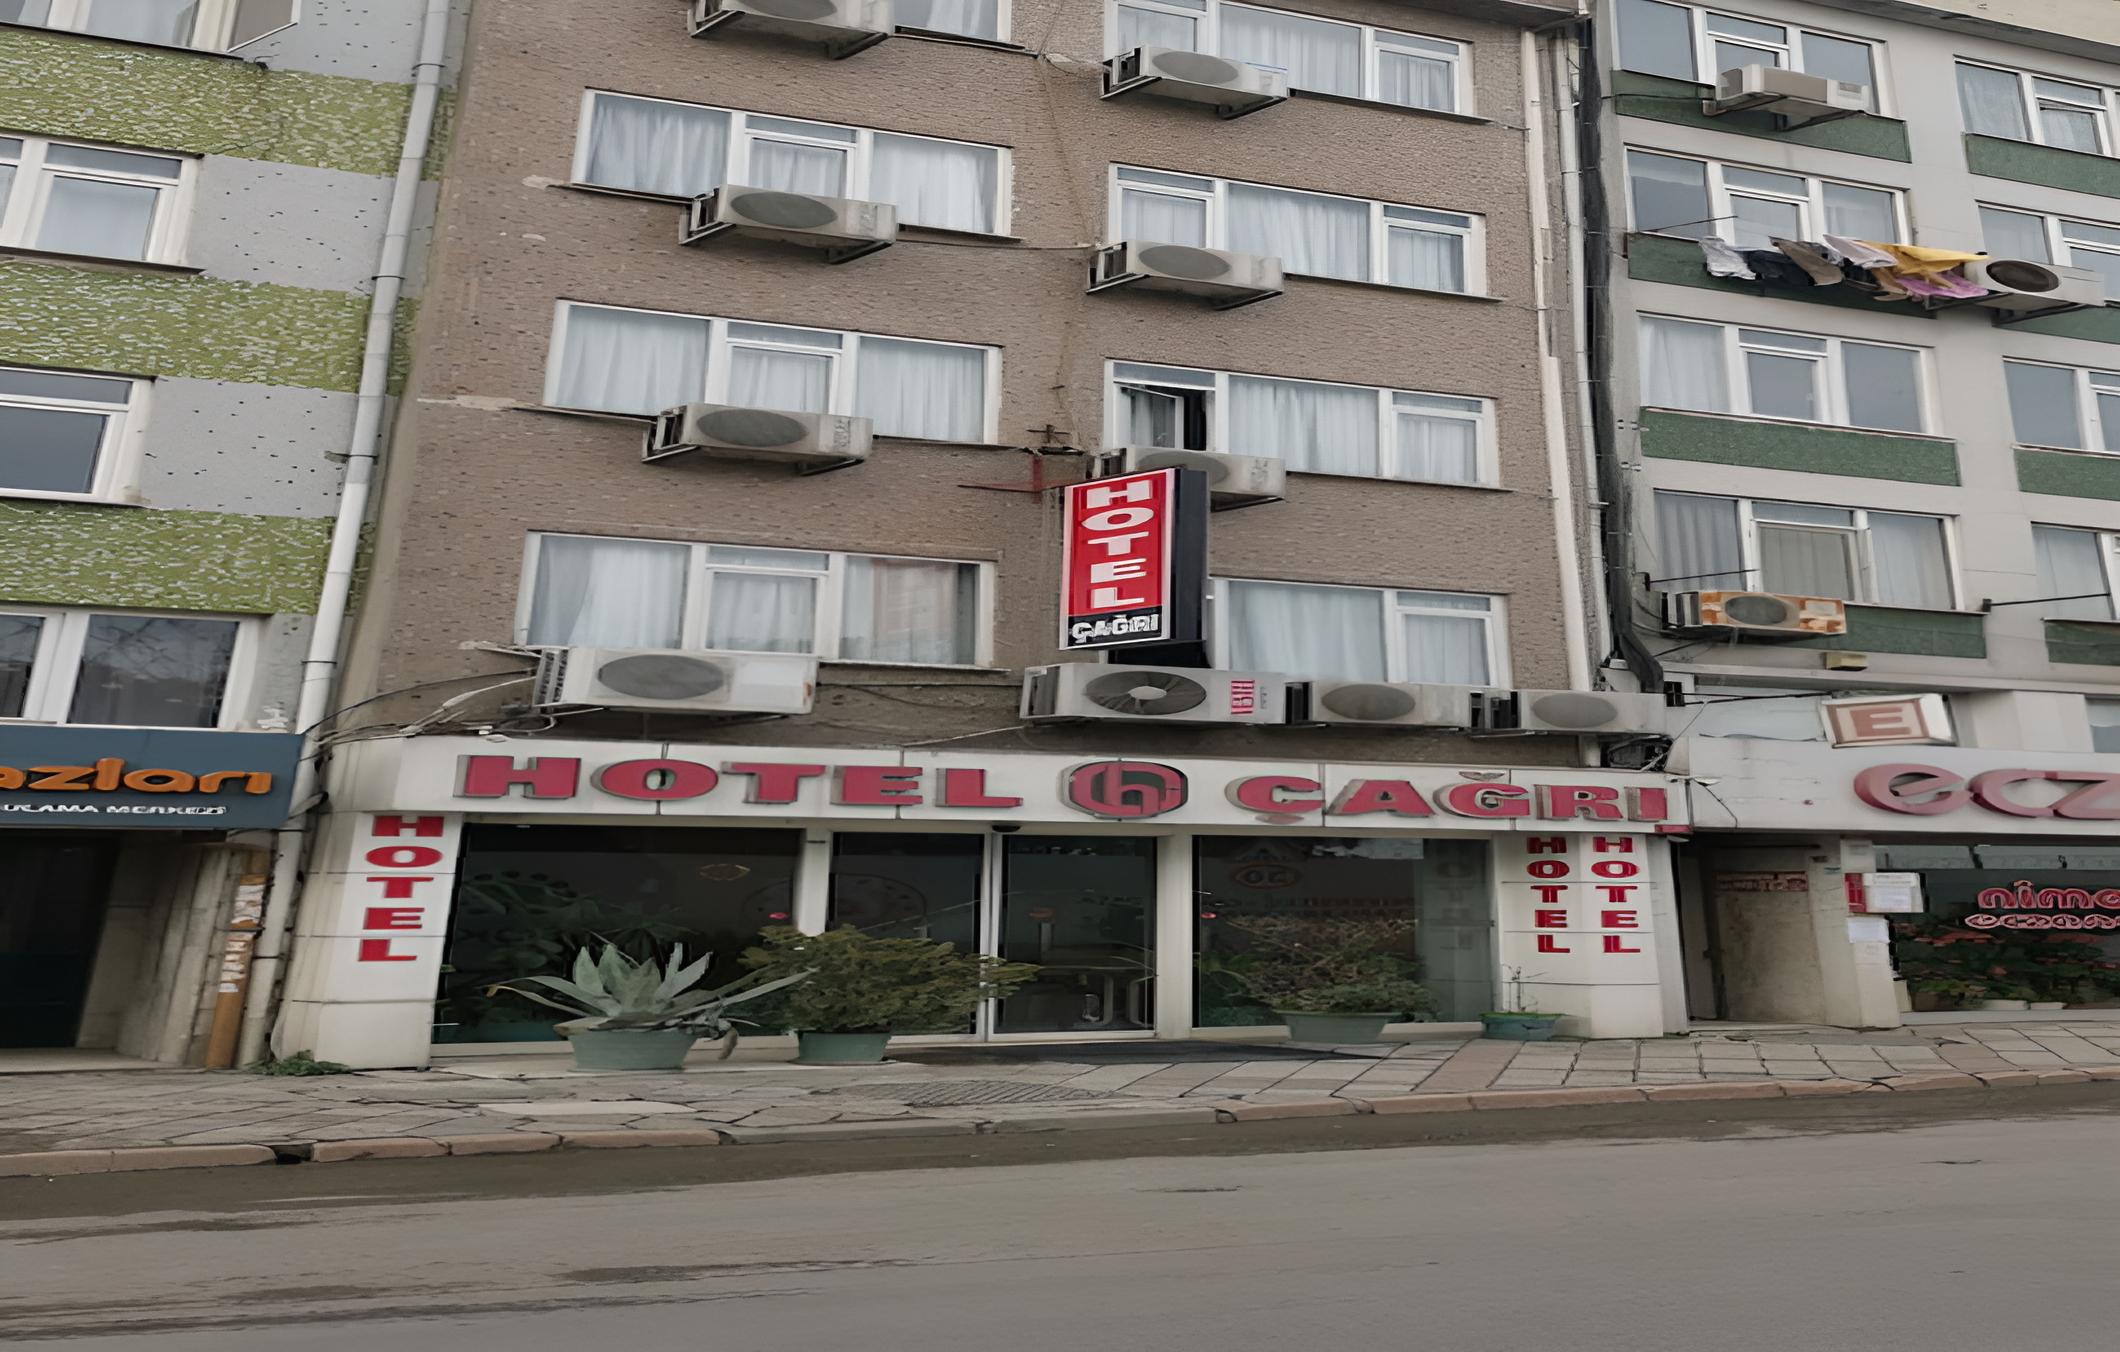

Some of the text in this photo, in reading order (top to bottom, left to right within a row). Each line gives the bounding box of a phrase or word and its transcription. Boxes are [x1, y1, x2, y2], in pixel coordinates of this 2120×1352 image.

[1081, 480, 1155, 610] HOTEL
[1850, 706, 1912, 738] E
[0, 803, 99, 814] ULAMA
[454, 755, 1024, 808] HOTEL
[1224, 771, 1668, 825] ÇAĞRI
[358, 816, 444, 962] HOTEL
[1526, 836, 1571, 954] HOTEL
[1591, 836, 1641, 954] HOTEL
